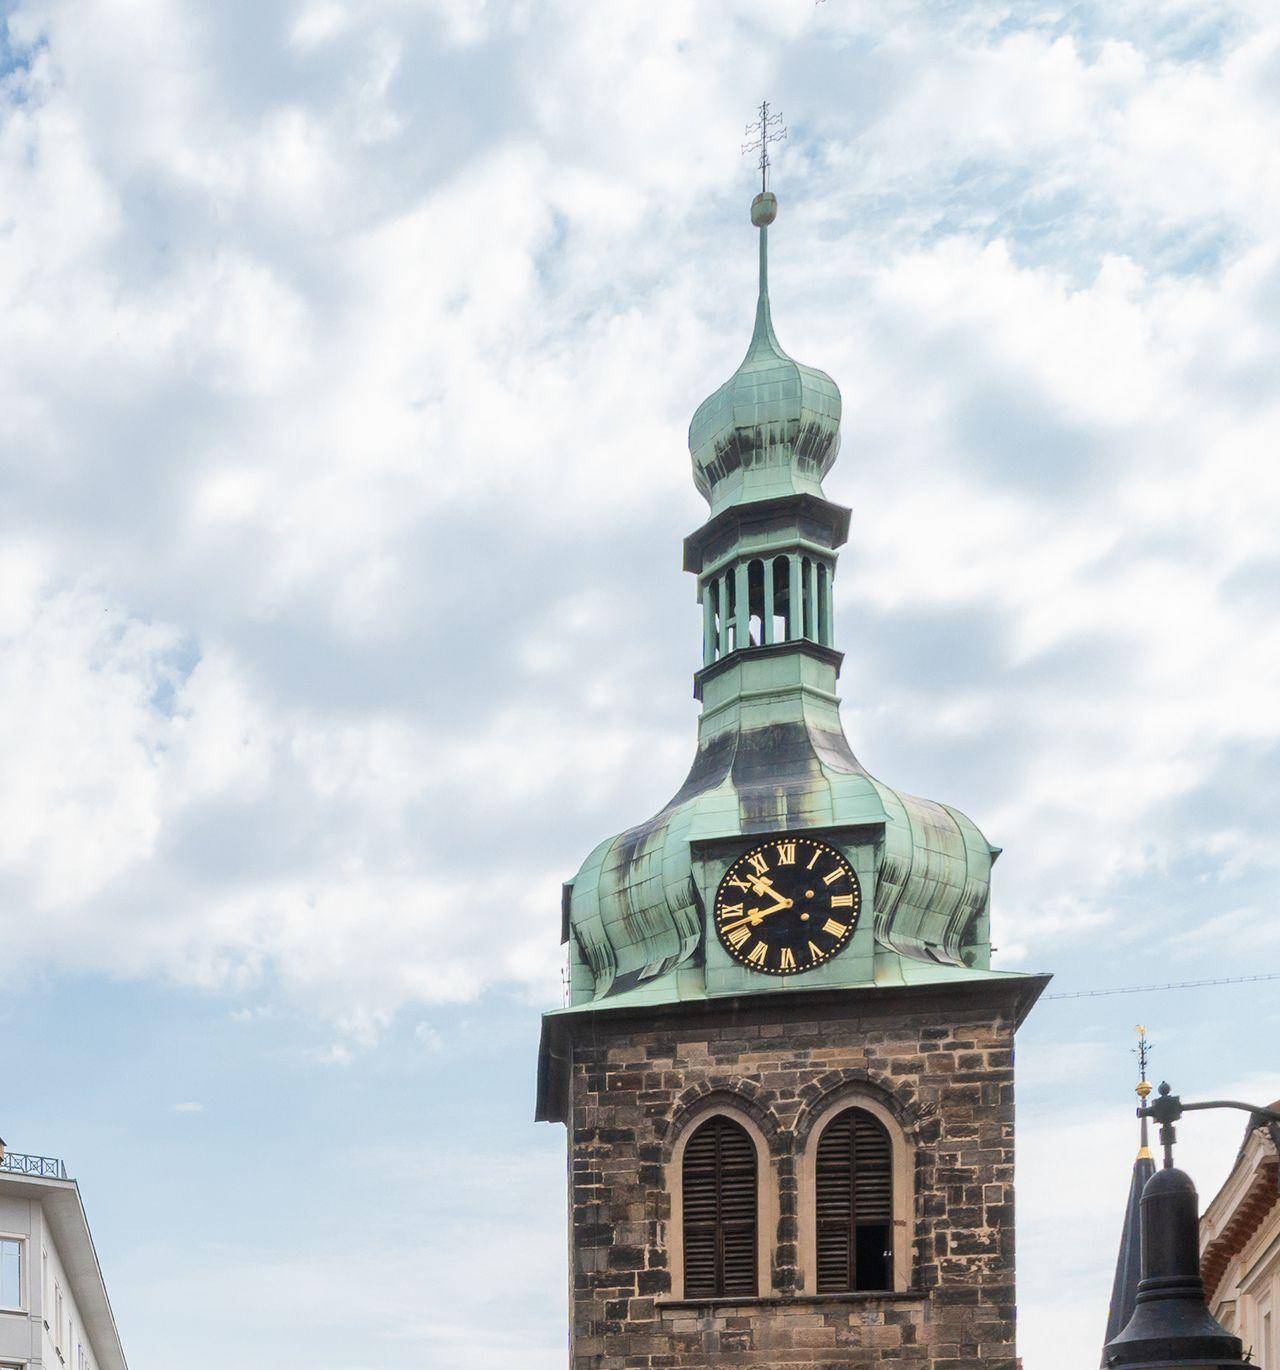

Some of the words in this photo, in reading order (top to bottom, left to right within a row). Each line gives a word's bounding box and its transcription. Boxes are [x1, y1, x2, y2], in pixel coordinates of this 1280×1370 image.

[748, 853, 770, 876] XI
[777, 843, 796, 866] XII
[807, 849, 822, 870] I
[729, 875, 751, 893] X
[823, 867, 845, 885] II
[831, 894, 853, 908] III
[822, 918, 847, 939] IIII
[808, 941, 824, 960] V
